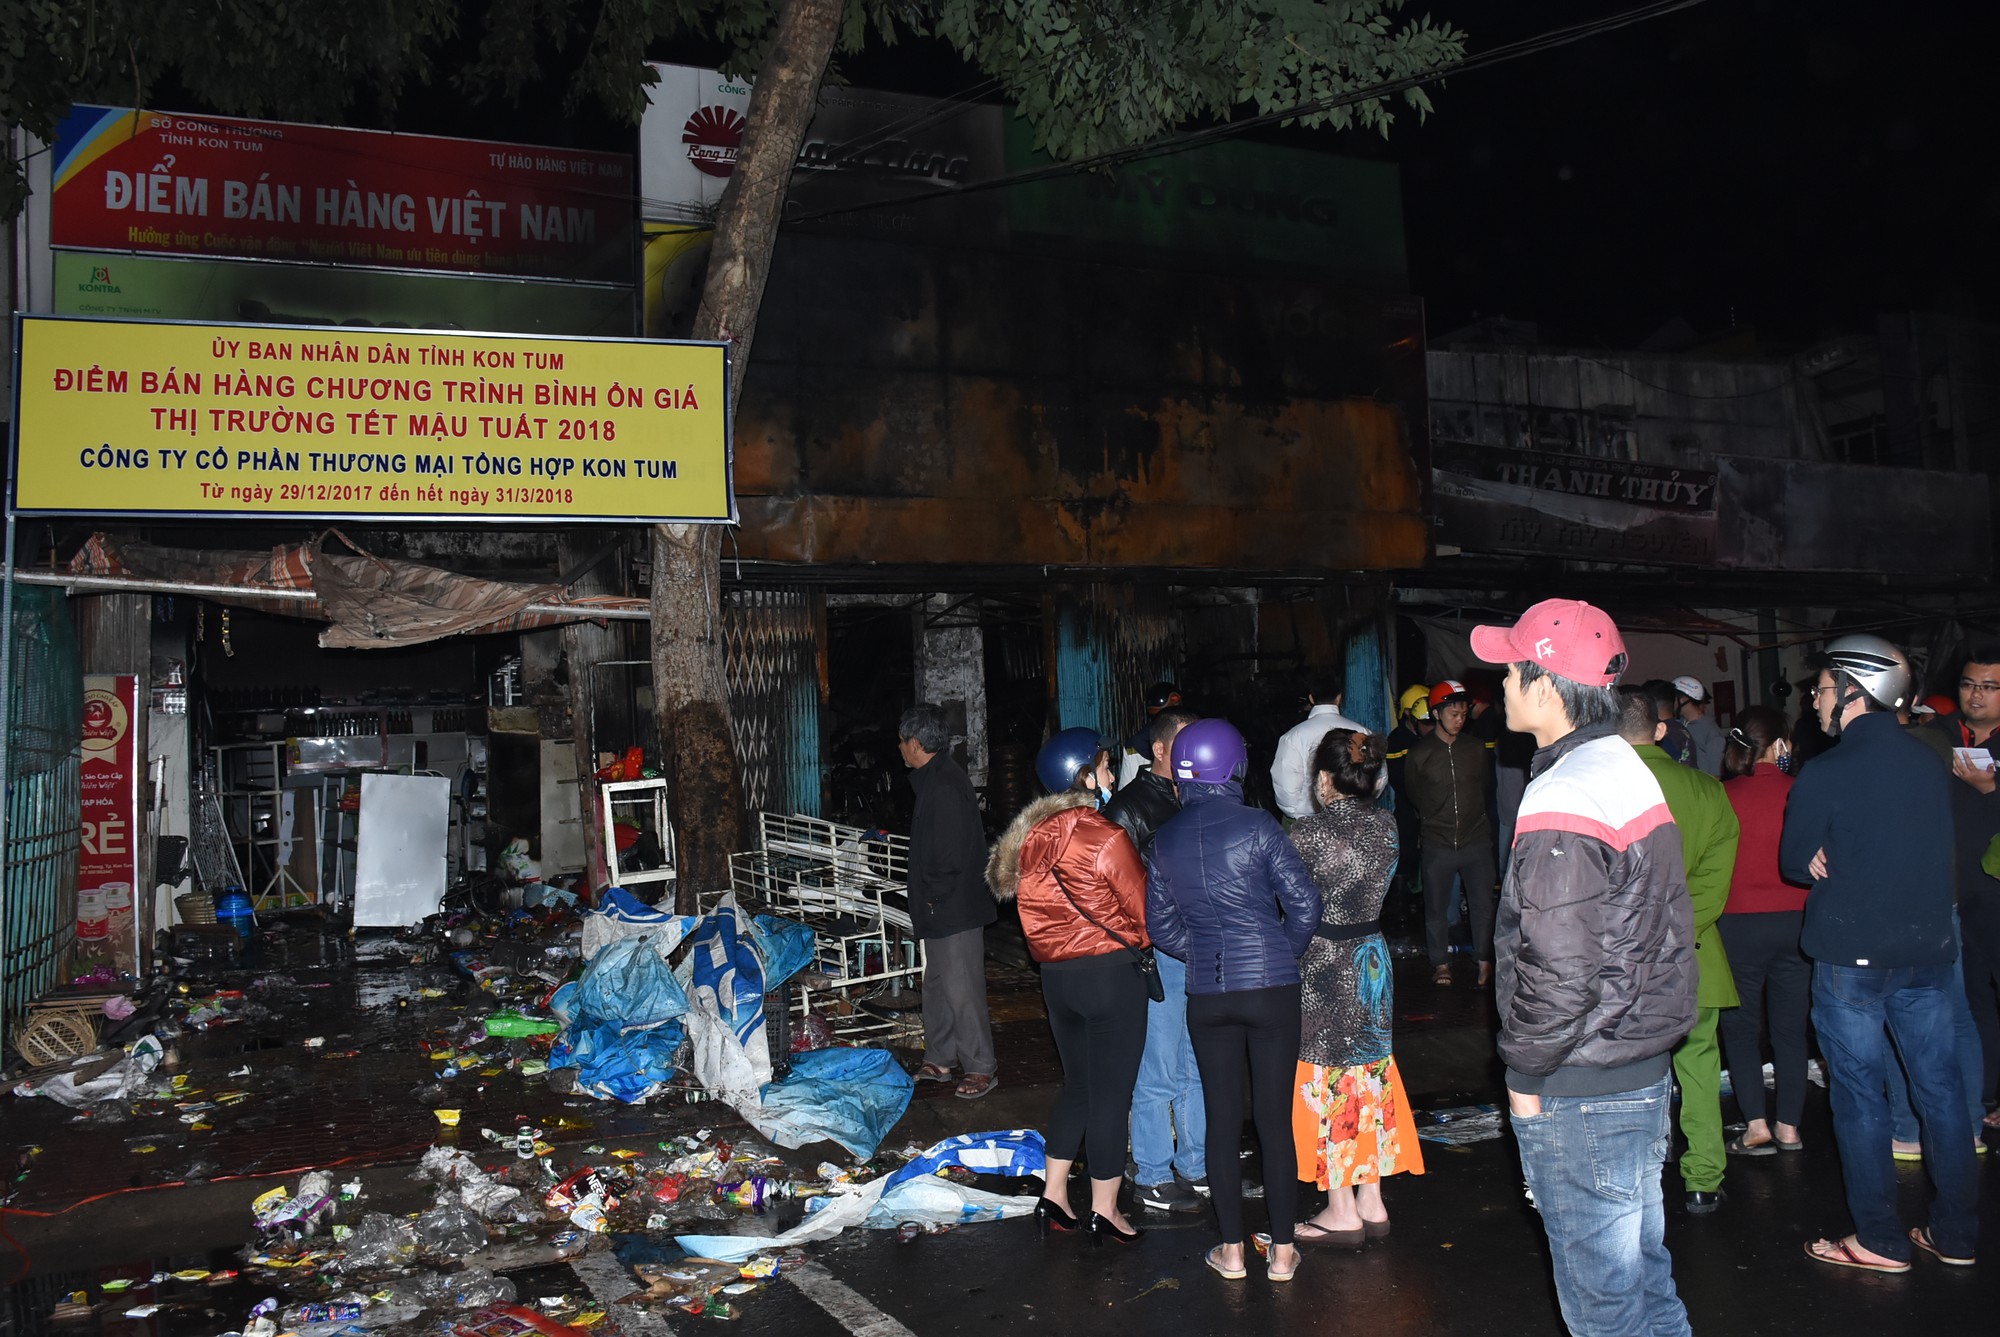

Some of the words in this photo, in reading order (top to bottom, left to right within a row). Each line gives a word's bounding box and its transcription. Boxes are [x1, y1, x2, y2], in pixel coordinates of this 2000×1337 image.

[718, 84, 746, 96] CÔNG
[151, 117, 172, 130] SỞ
[159, 132, 194, 146] TỈNH
[198, 138, 229, 149] KON
[233, 140, 264, 152] TUM
[490, 152, 505, 171] TỰ
[509, 152, 533, 171] HÀO
[536, 154, 566, 174] HÀNG
[569, 158, 595, 177] VIỆT
[598, 163, 624, 178] NAM
[104, 154, 208, 217] ĐIỂM
[223, 172, 301, 224] BÁN
[316, 179, 416, 233] HÀNG
[426, 189, 507, 245] VIỆT
[520, 203, 596, 244] NAM
[128, 226, 171, 247] Hưởng
[175, 230, 199, 249] ứng
[376, 243, 404, 260] Nam
[406, 247, 422, 262] ưu
[425, 248, 450, 264] tiên
[452, 250, 481, 268] dùng
[78, 283, 121, 294] KONTRA
[212, 336, 240, 358] ỦY
[249, 341, 292, 360] BAN
[302, 341, 359, 363] NHÂN
[368, 343, 410, 364] DÂN
[418, 344, 464, 366] TỈNH
[474, 350, 515, 369] KON
[523, 352, 564, 370] TUM
[53, 364, 128, 393] ĐIỂM
[141, 367, 201, 395] BÁN
[214, 369, 295, 397] HÀNG
[307, 376, 432, 402] CHƯƠNG
[443, 377, 523, 405] TRÌNH
[535, 379, 596, 407] BÌNH
[607, 382, 643, 408] ỔN
[654, 384, 699, 410] GIÁ
[151, 408, 197, 436] THỊ
[209, 405, 335, 435] TRƯỜNG
[346, 409, 398, 435] TẾT
[409, 412, 467, 442] MẬU
[479, 413, 548, 439] TUẤT
[558, 419, 616, 441] 2018
[80, 444, 149, 468] CÔNG
[158, 449, 188, 469] TY
[195, 446, 228, 470] CỔ
[238, 447, 299, 471] PHẦN
[309, 453, 406, 474] THƯƠNG
[416, 455, 454, 478] MẠI
[462, 452, 522, 475] TỔNG
[530, 457, 574, 480] HỢP
[583, 458, 626, 478] KON
[634, 460, 677, 479] TUM
[200, 482, 224, 499] Từ
[232, 484, 273, 503] ngày
[280, 485, 372, 501] 29/12/2017
[380, 483, 410, 501] đến
[417, 483, 443, 501] hết
[450, 486, 489, 506] ngày
[496, 487, 573, 504] 31/3/2018
[1496, 462, 1614, 496] THANH
[1619, 470, 1709, 507] THỦY
[97, 772, 110, 780] Cao
[111, 771, 124, 781] Cấp
